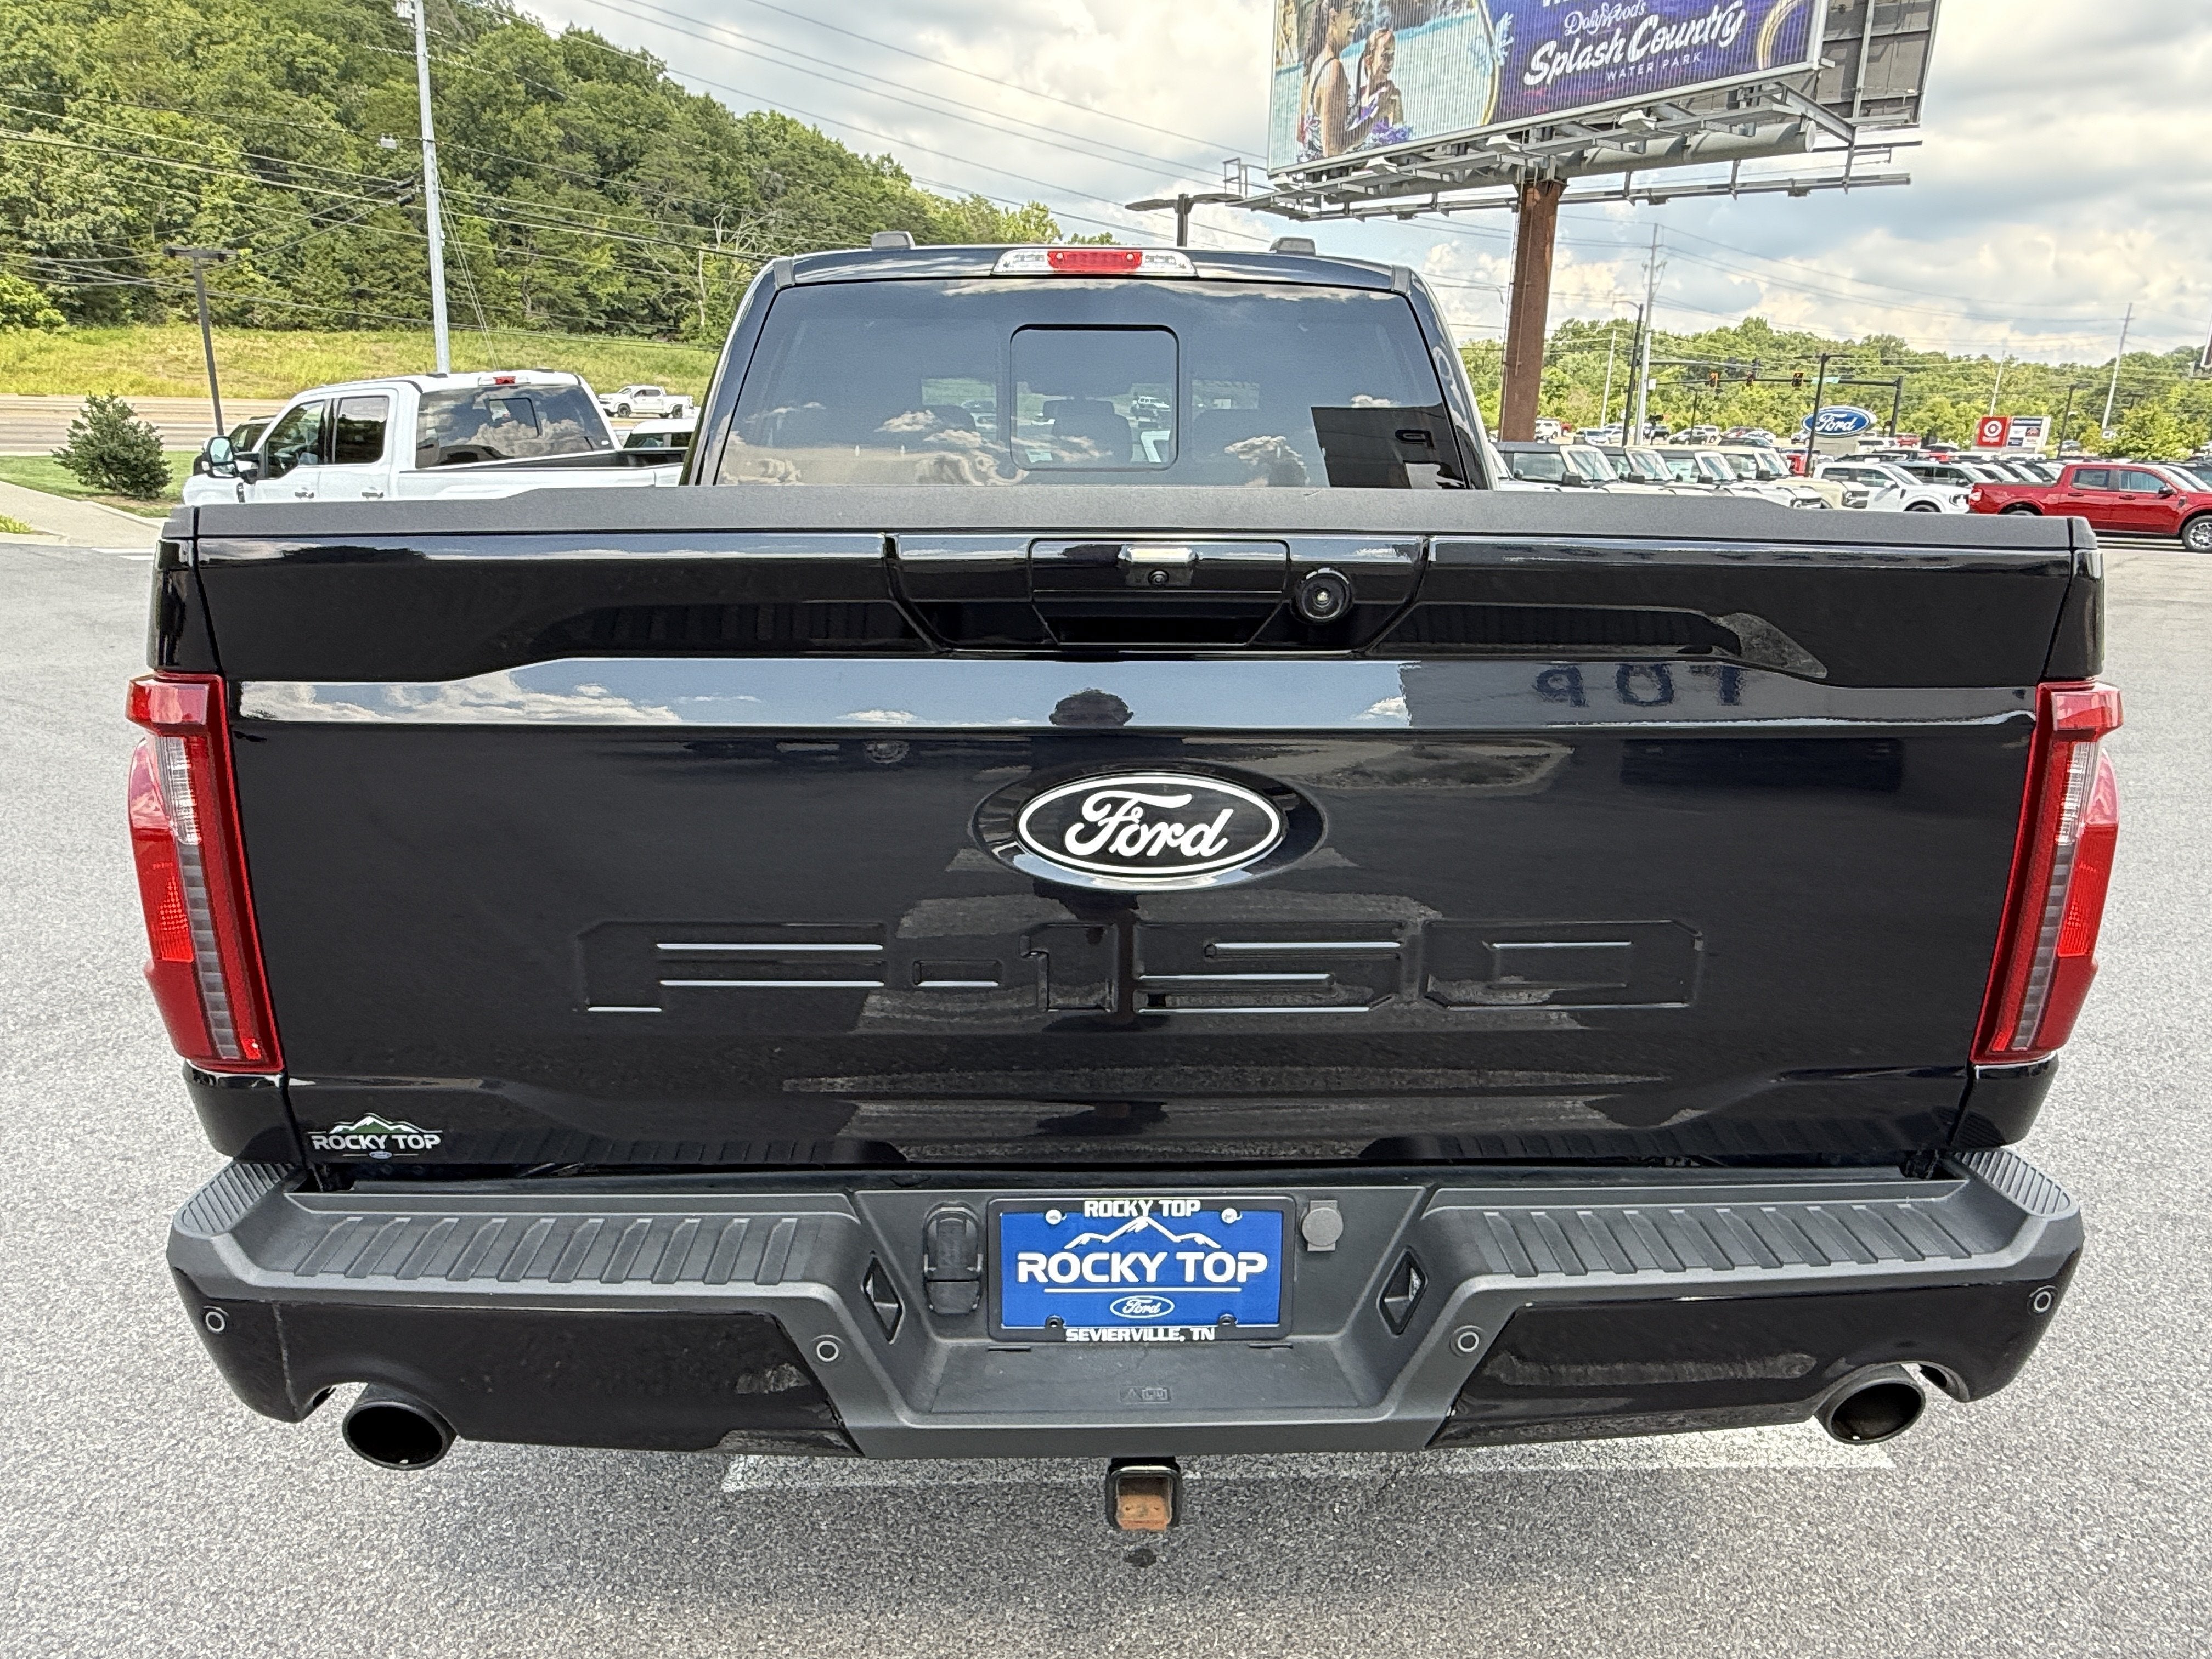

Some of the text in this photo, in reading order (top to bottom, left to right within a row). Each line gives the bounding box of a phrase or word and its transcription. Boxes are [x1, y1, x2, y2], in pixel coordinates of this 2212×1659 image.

[1523, 0, 1746, 85] Splash Country
[1607, 52, 1702, 81] WATER PARK
[1815, 413, 1858, 431] Ford
[1064, 790, 1234, 857] Ford
[576, 919, 1703, 1014] F-150
[311, 1135, 441, 1150] ROCKY TOP
[1084, 1200, 1200, 1217] ROCKY TOP
[1017, 1252, 1268, 1283] ROCKY TOP
[1122, 1299, 1162, 1314] Ford
[1065, 1327, 1216, 1342] SEVIERVILLE, TN
